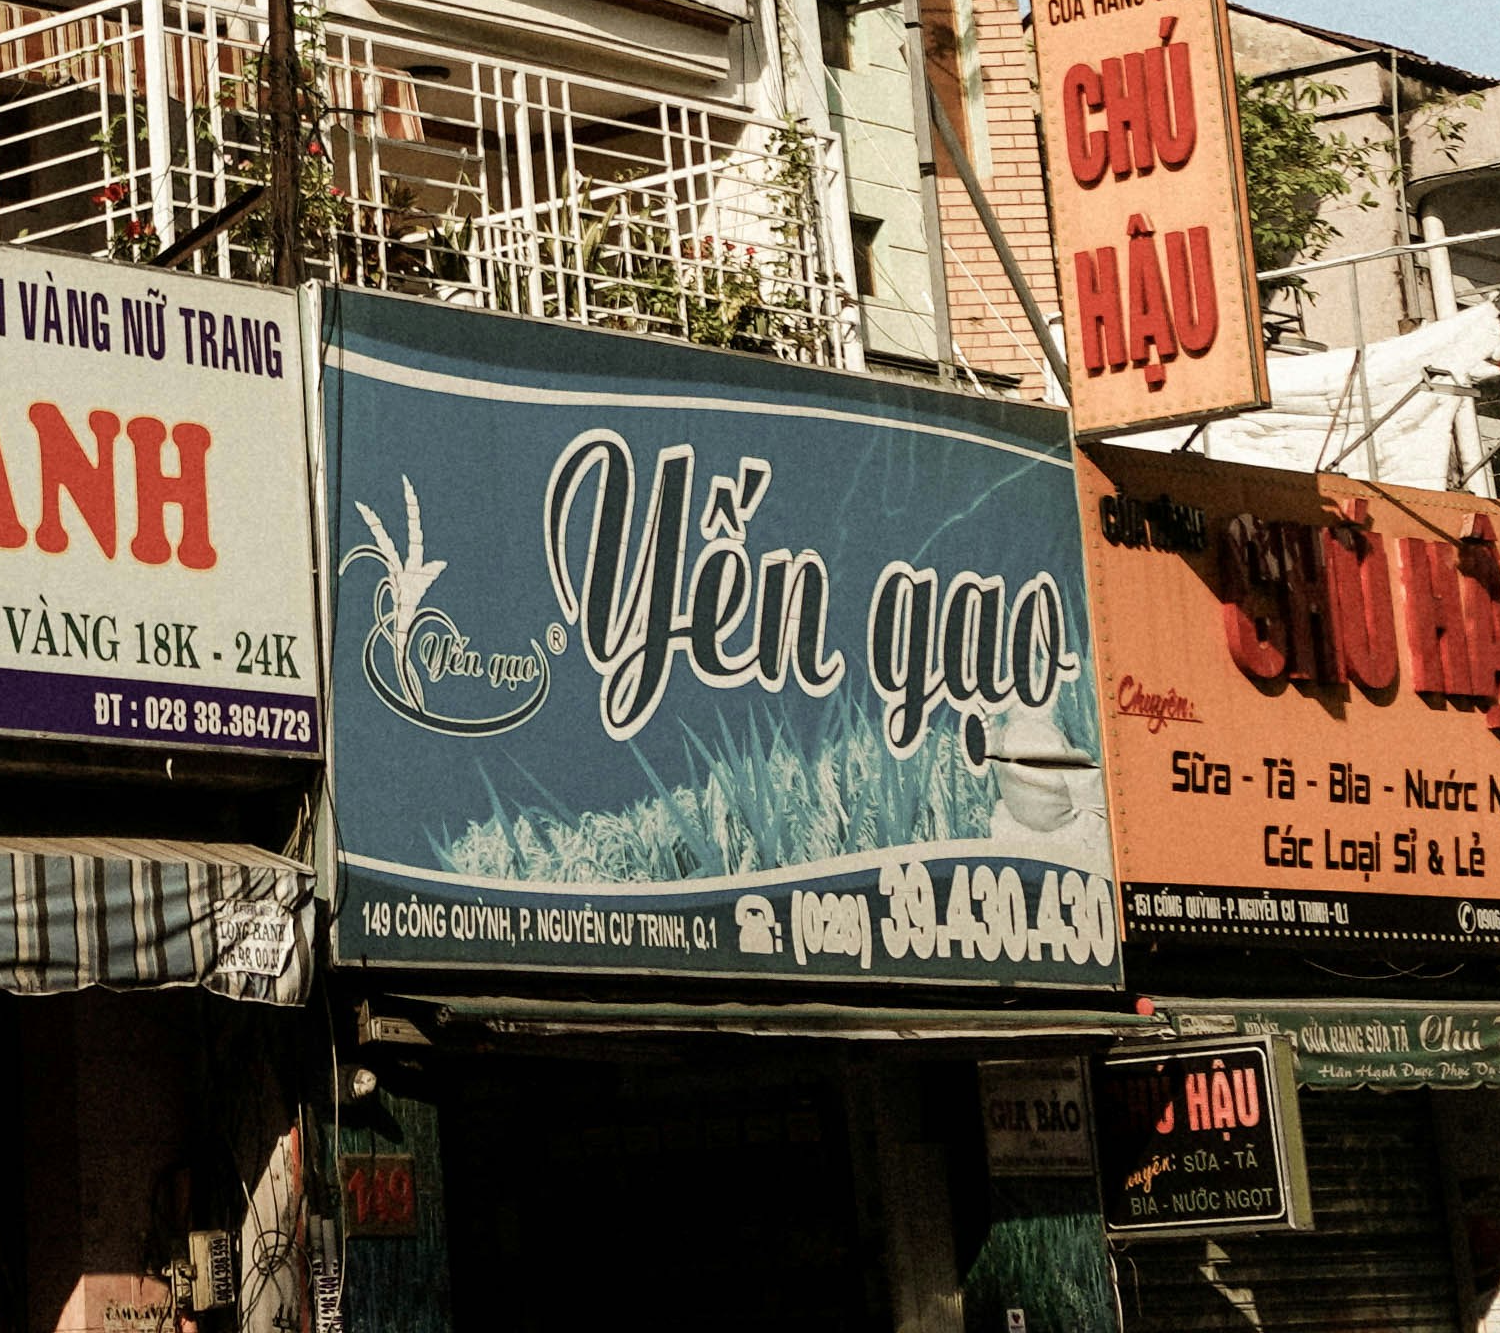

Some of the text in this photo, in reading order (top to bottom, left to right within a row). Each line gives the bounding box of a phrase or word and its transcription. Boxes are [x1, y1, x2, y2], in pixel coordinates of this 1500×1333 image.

[1063, 15, 1199, 191] CHÚ
[18, 270, 111, 353] VÀNG
[122, 287, 167, 362] NỮ
[180, 306, 284, 379] TRANG
[1074, 213, 1220, 393] HẬU
[543, 427, 1080, 776] Yến gạo
[1219, 498, 1399, 691] CHÚ
[3, 593, 120, 664] VÀNG
[135, 621, 201, 670] 18K
[234, 630, 302, 680] 24K
[488, 652, 541, 692] gạo
[95, 691, 124, 727] ĐT
[143, 696, 188, 733] 028
[193, 702, 312, 744] 38.364723
[1172, 749, 1232, 796] Sữa
[1263, 757, 1296, 801] Tã
[1329, 762, 1371, 805] Bia
[1404, 768, 1478, 813] Nước
[1263, 824, 1486, 883] Các Loại Sỉ & Lẻ
[361, 901, 392, 936] 149
[450, 897, 518, 949] QUỲNH,
[519, 909, 535, 942] P.
[537, 903, 607, 946] NGUYỄN
[609, 911, 636, 946] CƯ
[637, 914, 691, 955] TRINH,
[692, 916, 719, 950] Q.1
[792, 888, 872, 969] (028)
[878, 860, 1116, 967] 39.430.430
[1133, 893, 1152, 917] 151
[1153, 886, 1183, 918] CỐNG
[1476, 908, 1500, 931] 0906
[1301, 1016, 1331, 1054] CỬA
[1330, 1019, 1365, 1054] HÀNG
[1365, 1018, 1392, 1054] SỮA
[1419, 1014, 1486, 1053] Chú
[1184, 1058, 1260, 1142] HẬU
[1183, 1144, 1259, 1173] SỮA TÃ
[348, 1167, 416, 1225] 149
[1130, 1187, 1274, 1217] BIA NƯỚC NGỌT
